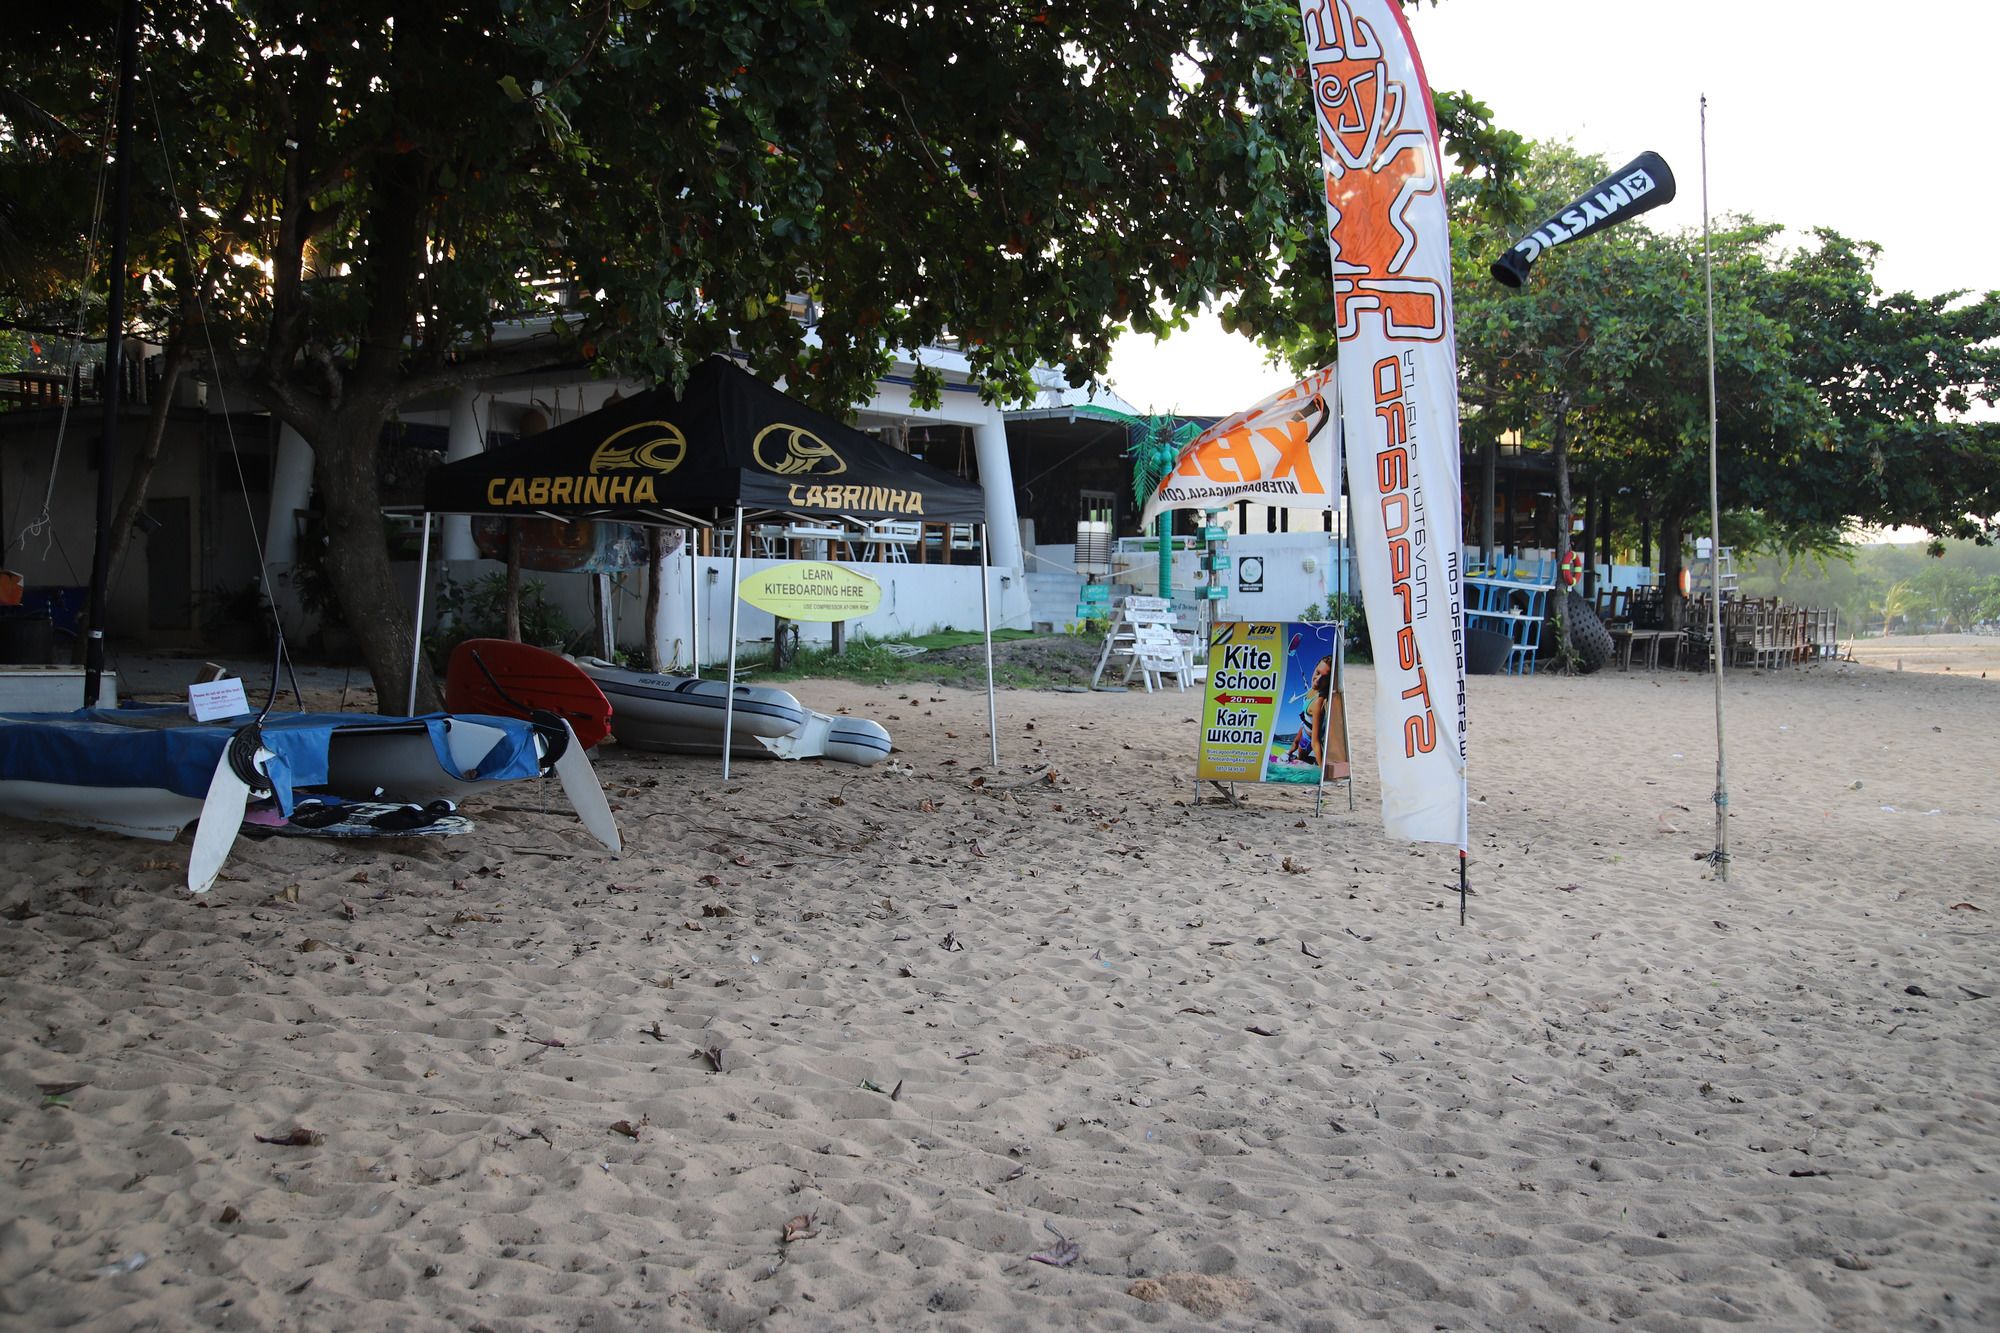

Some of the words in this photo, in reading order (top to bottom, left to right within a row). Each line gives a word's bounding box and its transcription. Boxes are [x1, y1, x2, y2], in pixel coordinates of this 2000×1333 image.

[1515, 184, 1631, 263] MYSTIC
[487, 476, 659, 506] CABRINHA
[788, 483, 924, 515] CABRINHA
[802, 569, 833, 580] LEARN
[765, 583, 838, 596] KITEBOARDING
[840, 585, 864, 597] HERE
[1224, 646, 1272, 670] Kite
[1214, 671, 1277, 690] School
[1217, 709, 1258, 726] Кайт
[1207, 729, 1263, 744] школа
